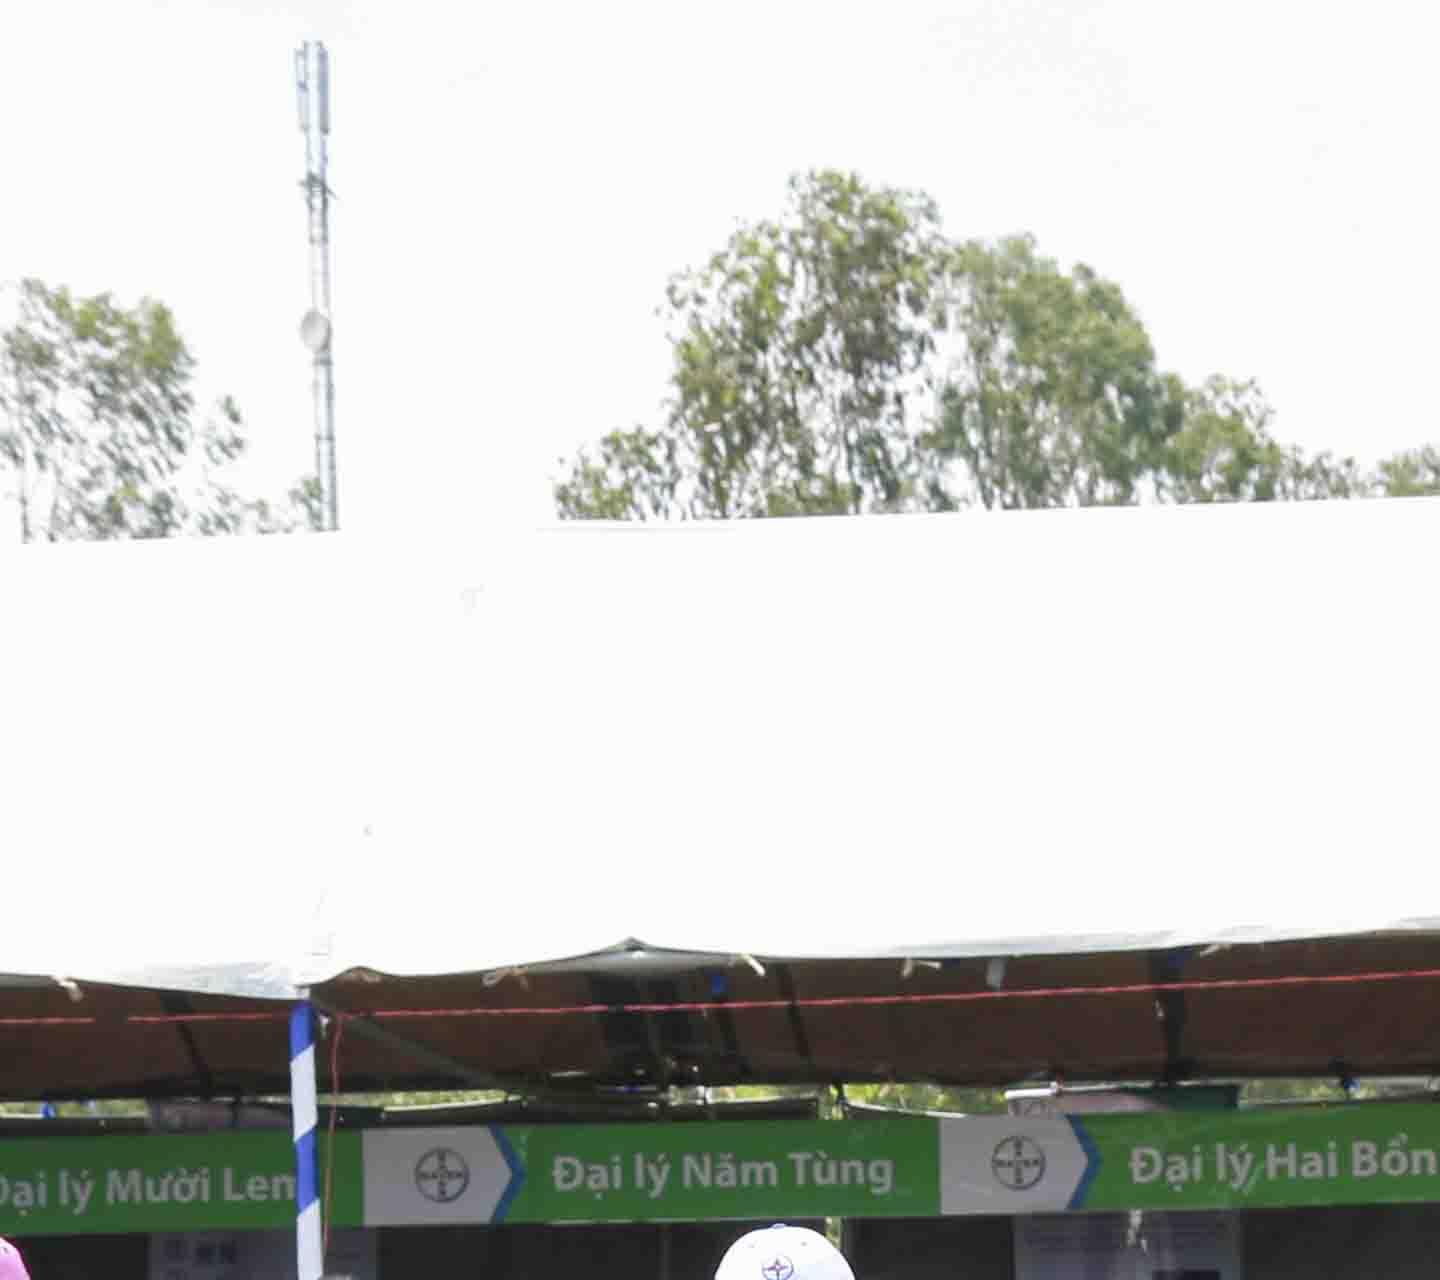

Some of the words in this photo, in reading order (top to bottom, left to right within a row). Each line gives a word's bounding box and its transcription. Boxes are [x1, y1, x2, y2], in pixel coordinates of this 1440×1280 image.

[552, 1156, 622, 1198] Đại
[635, 1153, 670, 1198] lý
[683, 1153, 777, 1187] Năm
[788, 1152, 894, 1194] Tùng
[1128, 1146, 1201, 1192] Đại
[1216, 1144, 1253, 1193] lý
[1266, 1142, 1349, 1179] Hai
[60, 1170, 94, 1214] lý
[107, 1168, 209, 1204] Mười
